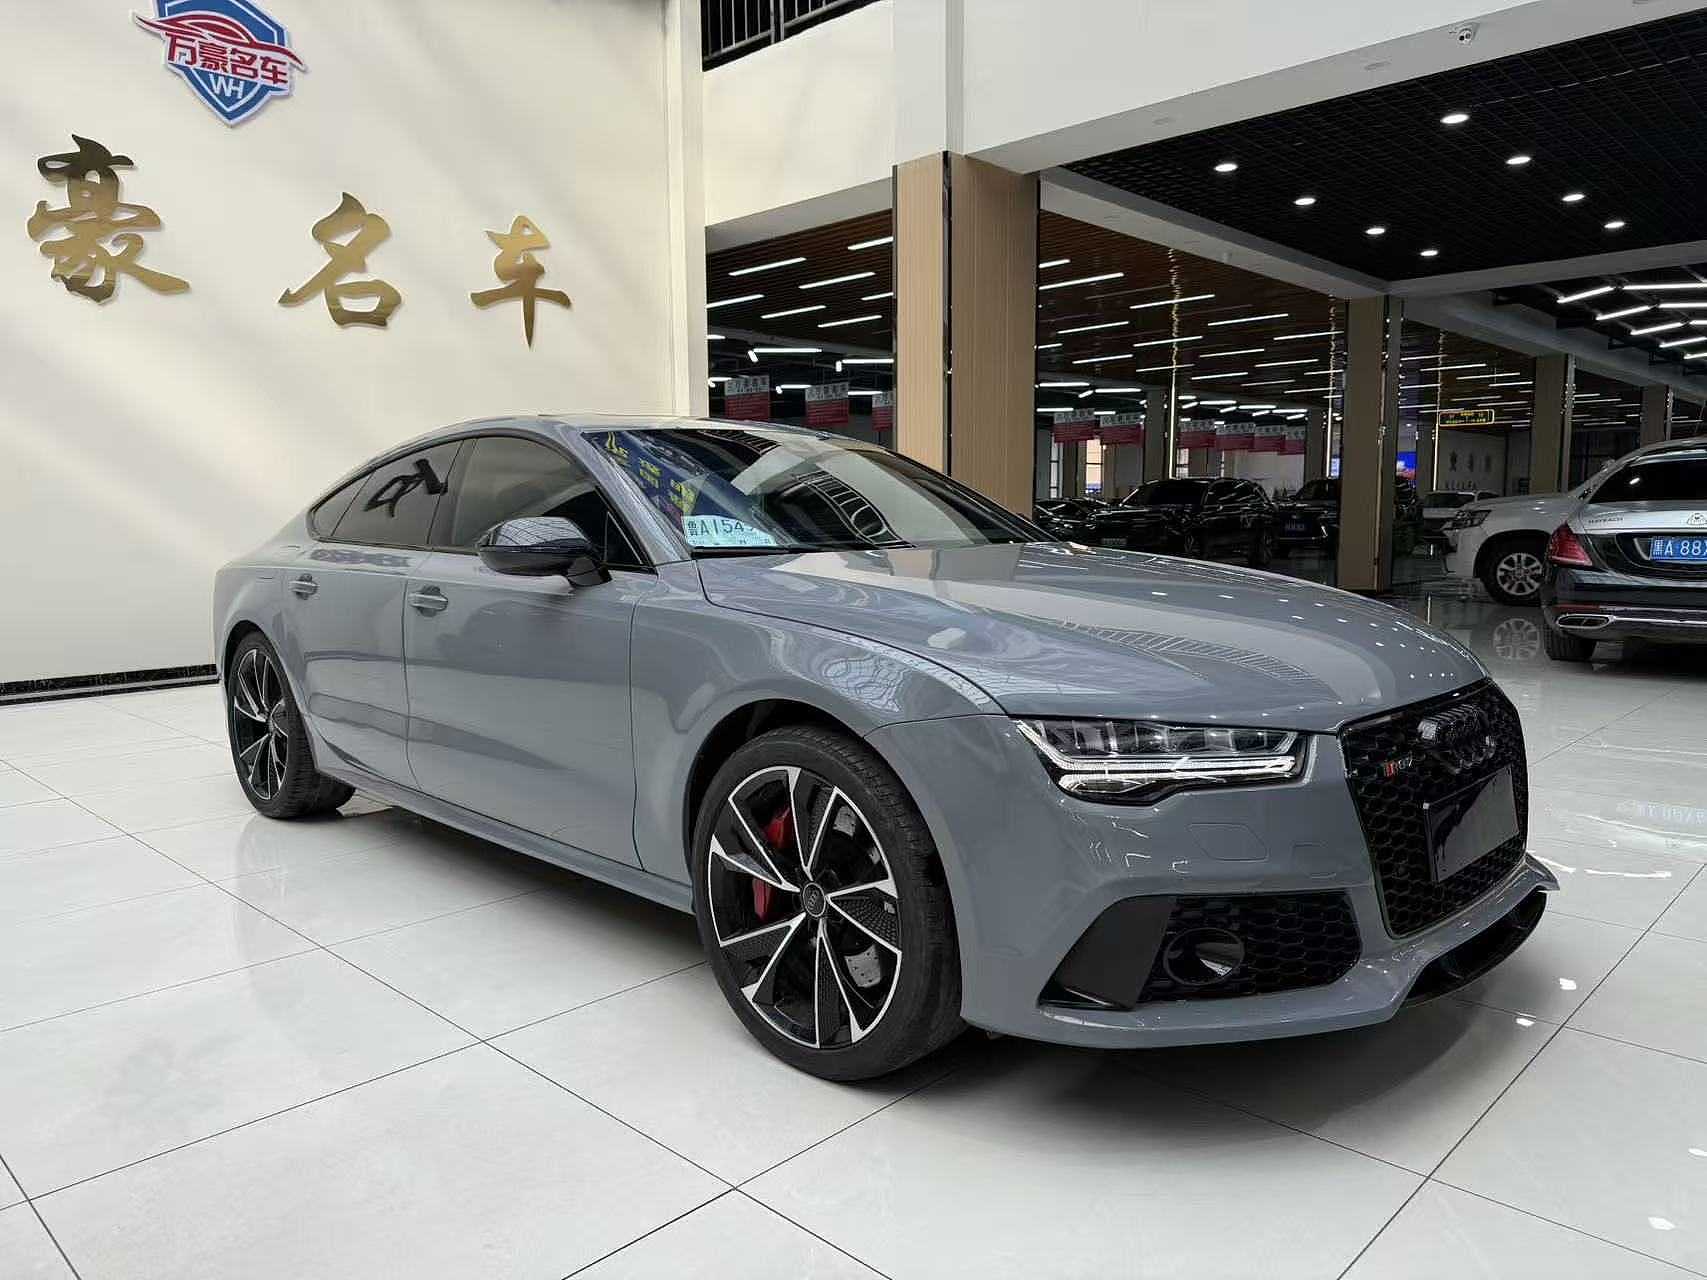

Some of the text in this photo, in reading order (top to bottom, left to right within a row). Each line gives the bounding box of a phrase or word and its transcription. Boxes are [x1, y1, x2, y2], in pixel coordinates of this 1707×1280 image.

[165, 31, 289, 85] 万豪名车
[208, 73, 245, 100] WH
[687, 519, 752, 537] 鲁A154
